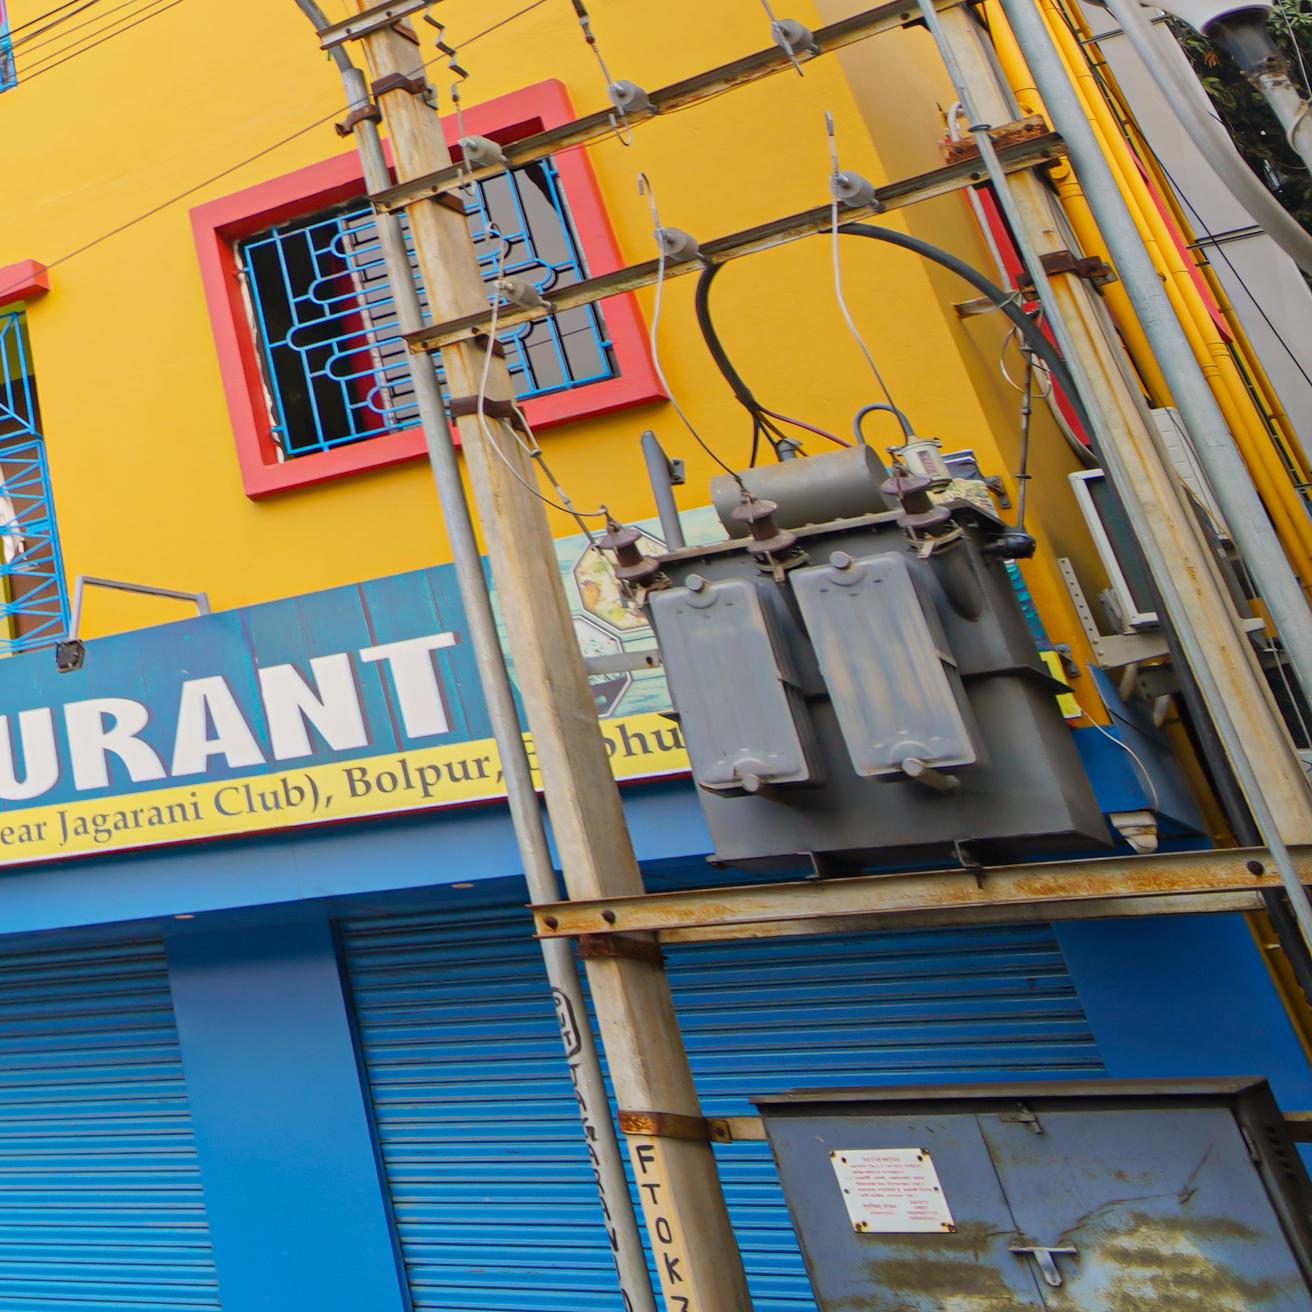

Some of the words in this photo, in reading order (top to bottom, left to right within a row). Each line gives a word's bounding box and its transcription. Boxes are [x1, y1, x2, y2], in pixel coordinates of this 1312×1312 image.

[56, 791, 203, 846] Jagarani
[214, 773, 334, 816] Club),
[348, 752, 505, 800] Bolpur,
